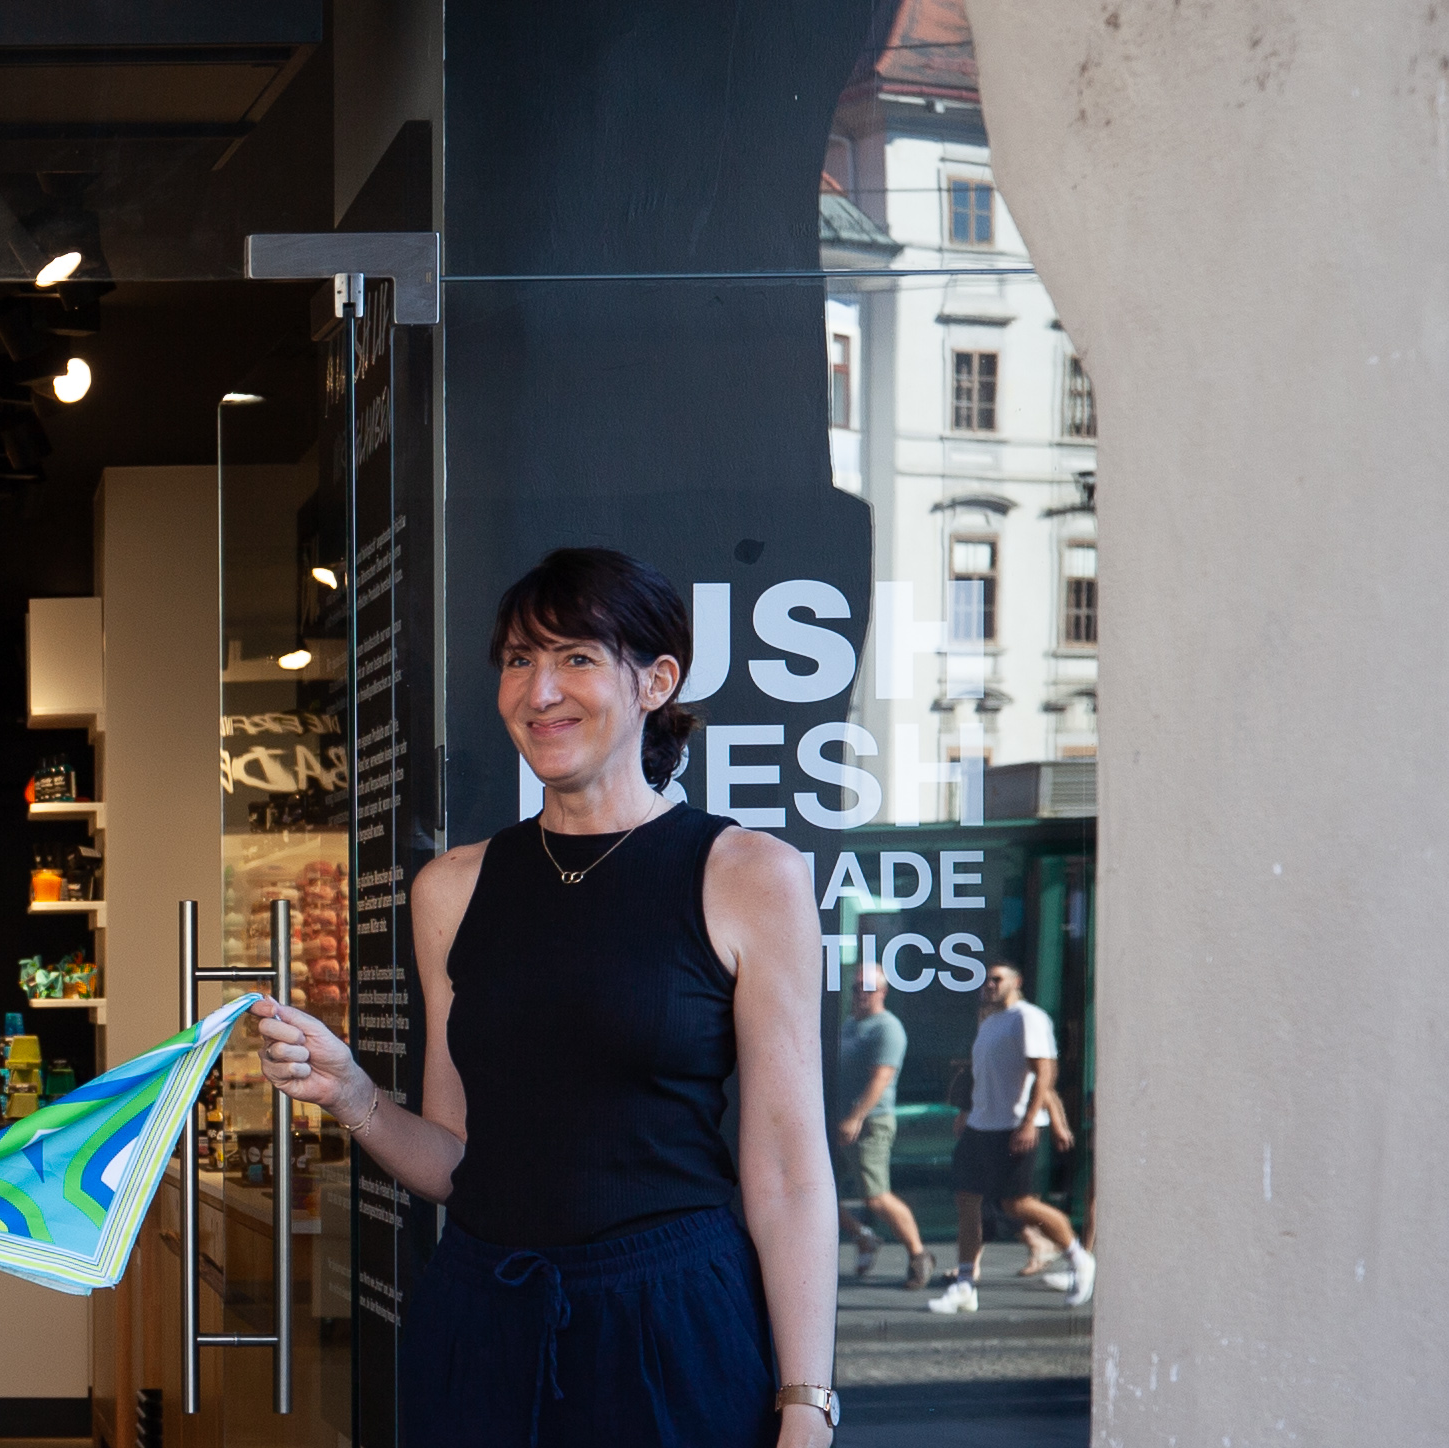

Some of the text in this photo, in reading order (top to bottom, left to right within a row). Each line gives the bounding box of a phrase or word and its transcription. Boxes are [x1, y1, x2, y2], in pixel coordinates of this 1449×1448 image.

[676, 579, 984, 703] USH
[802, 850, 987, 910] ADE
[822, 933, 987, 992] TICS
